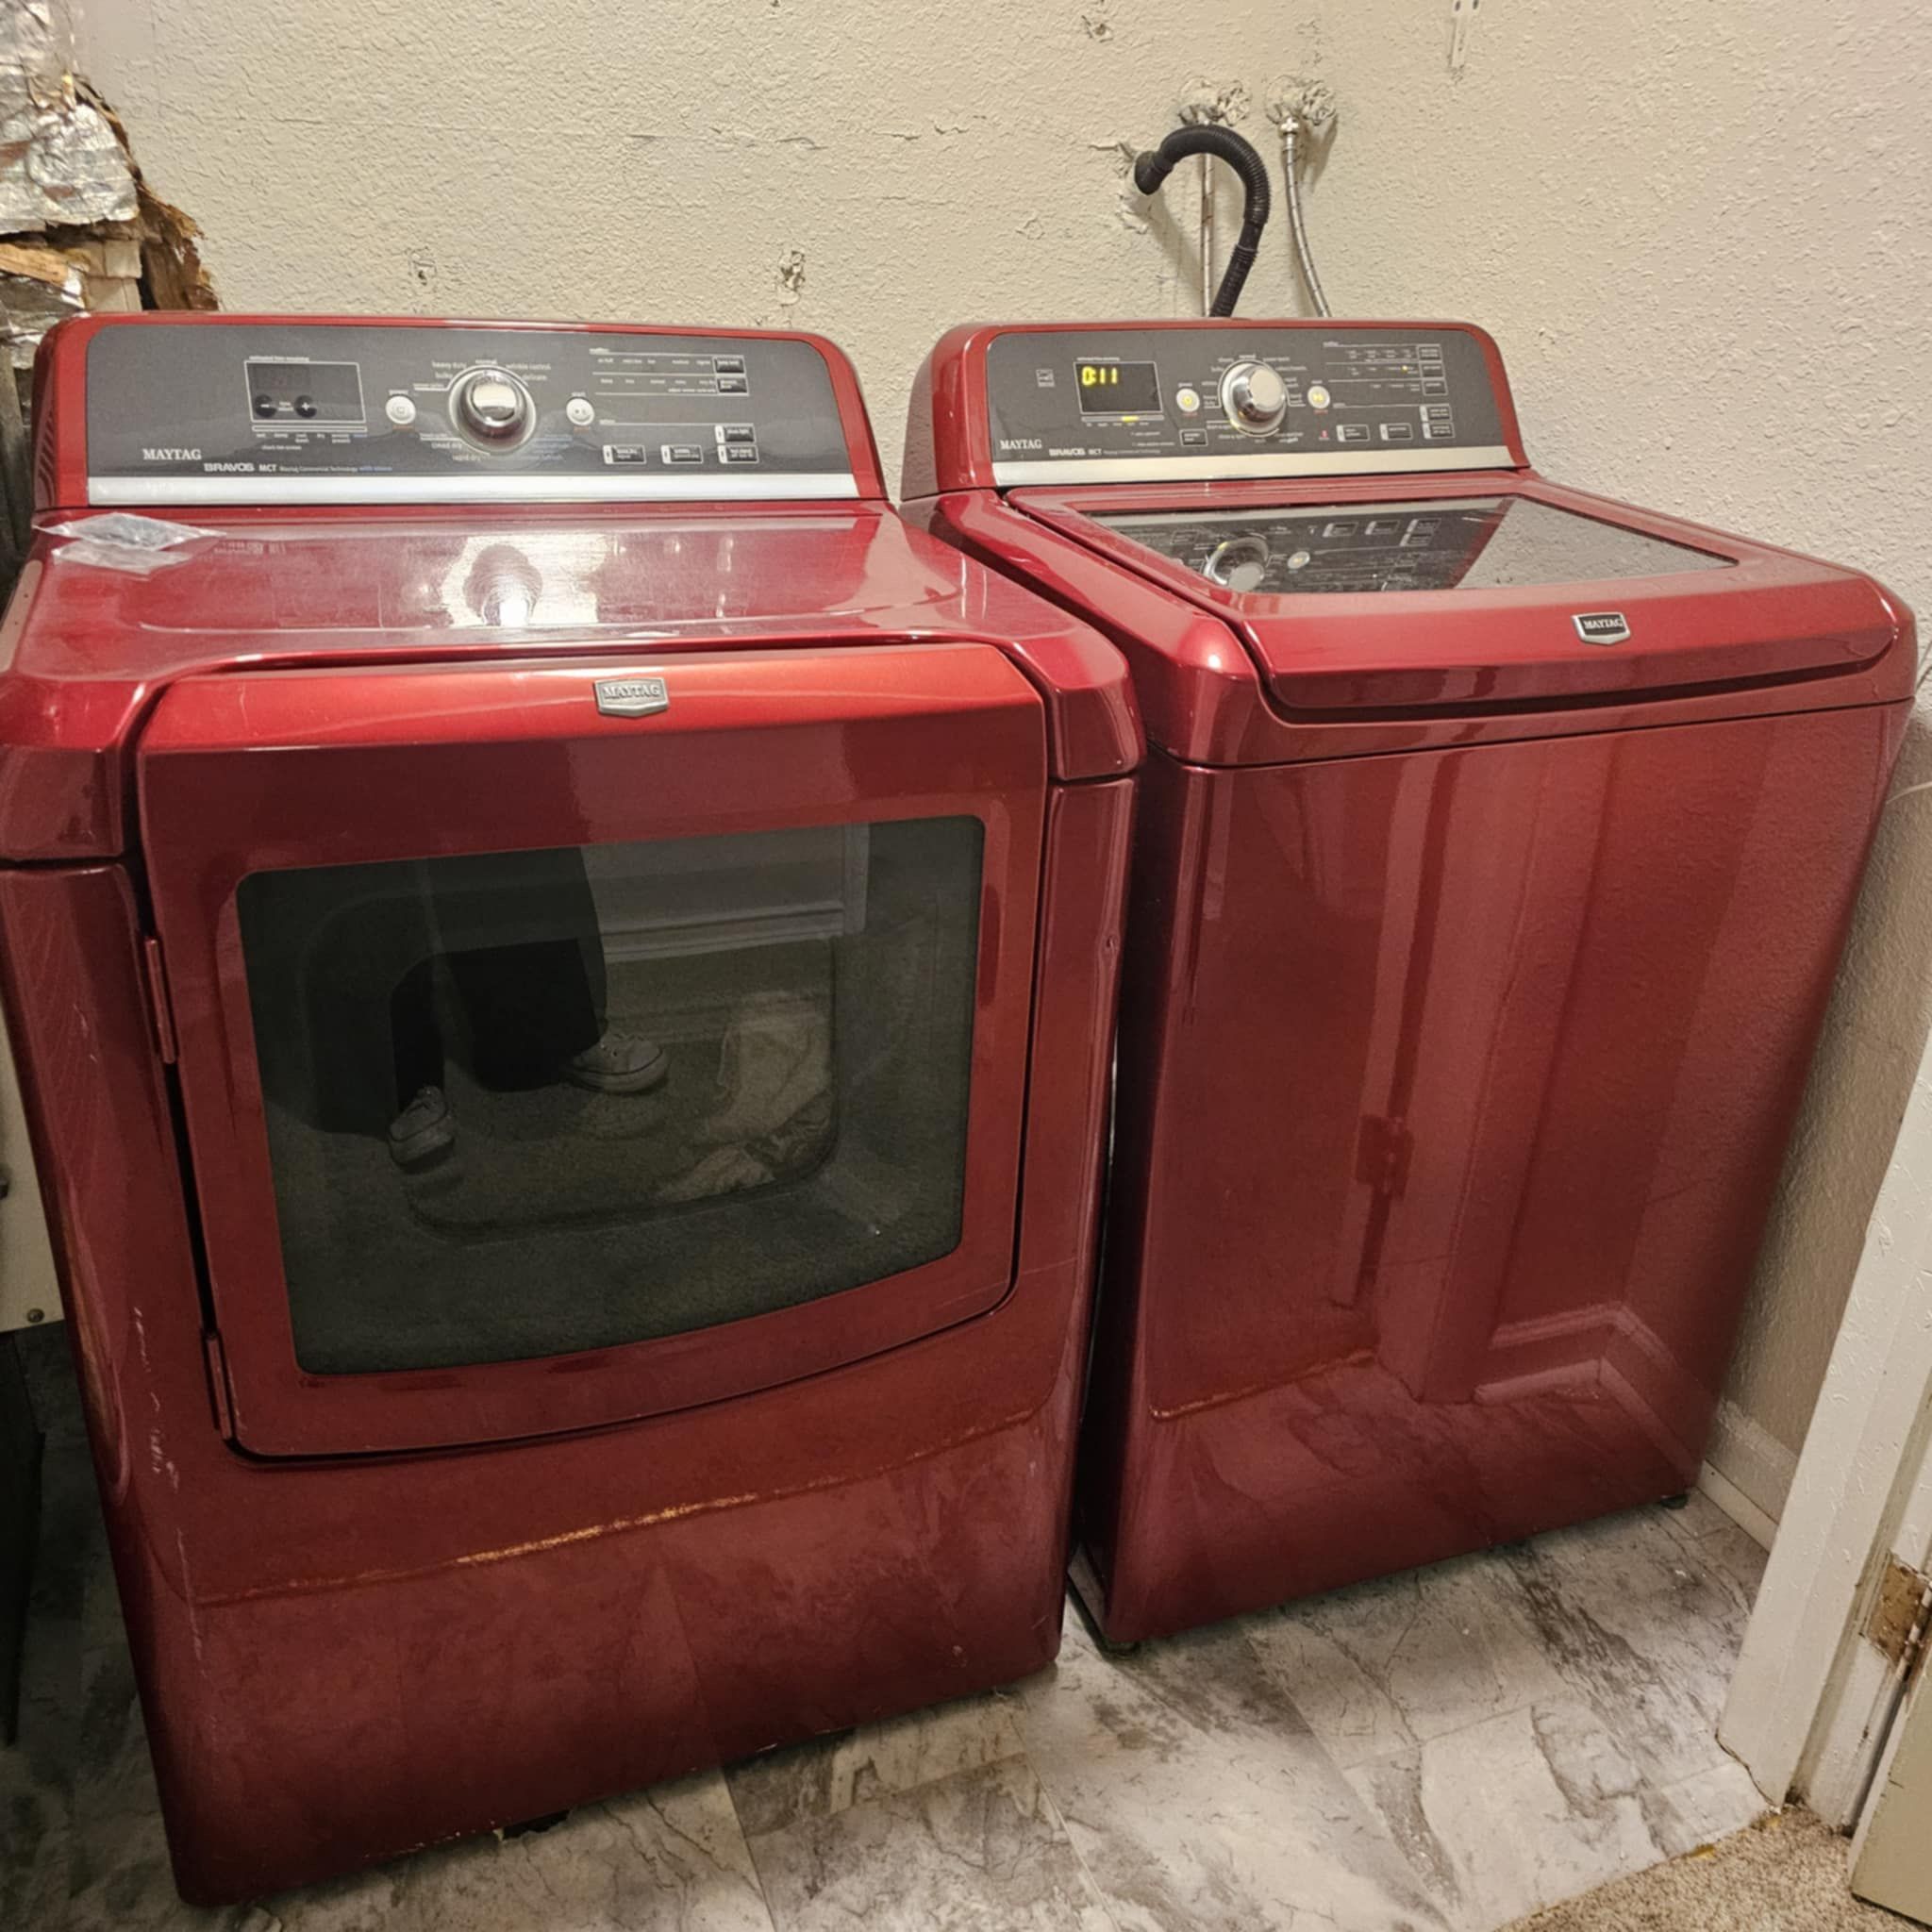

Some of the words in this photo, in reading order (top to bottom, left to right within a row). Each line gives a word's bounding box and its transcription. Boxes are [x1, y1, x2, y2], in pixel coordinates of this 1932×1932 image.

[999, 439, 1042, 450] MAYTAG
[142, 448, 202, 460] MAYTAG
[258, 463, 276, 473] MCT
[1583, 618, 1624, 629] MAYTAG
[603, 684, 660, 699] MAYTAG
